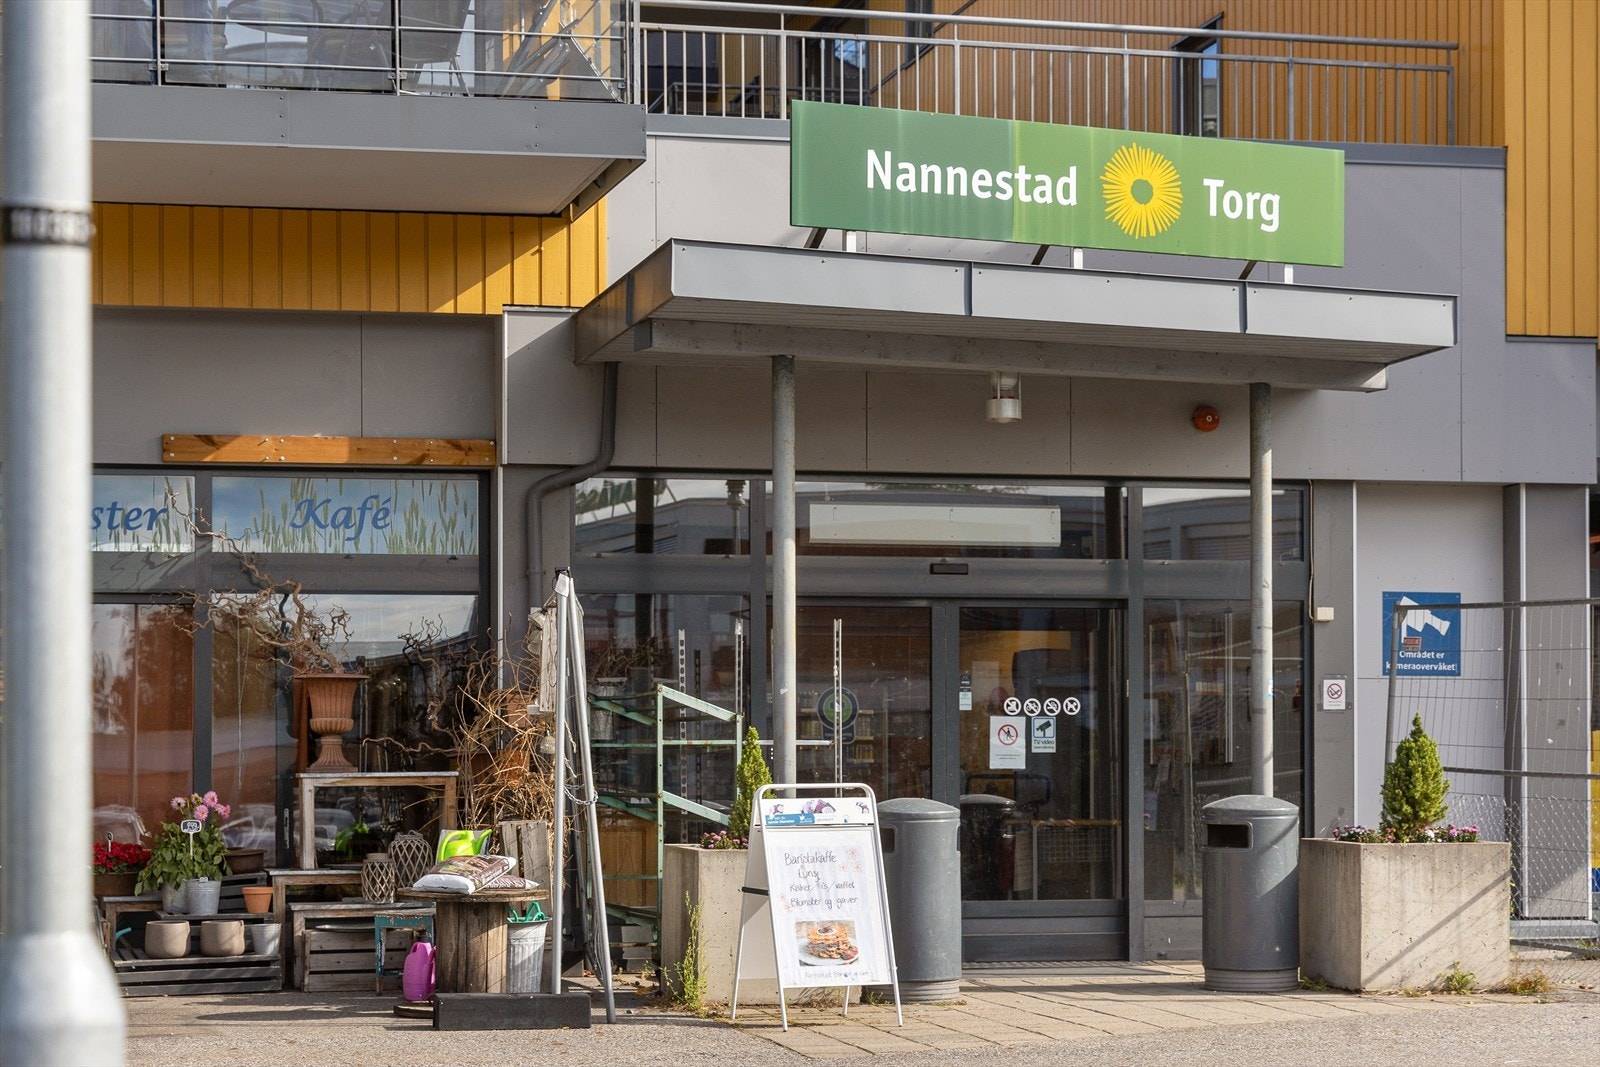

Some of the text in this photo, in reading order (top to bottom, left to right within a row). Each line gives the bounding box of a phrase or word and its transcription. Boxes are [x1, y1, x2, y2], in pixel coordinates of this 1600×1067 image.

[866, 149, 1281, 233] Nannestad Torg
[91, 494, 392, 542] ster Kafé
[1399, 650, 1435, 659] Området
[1385, 661, 1455, 671] kmeraovervåket
[784, 850, 837, 866] Baristakaffe
[790, 897, 858, 910] Blomster og gaver
